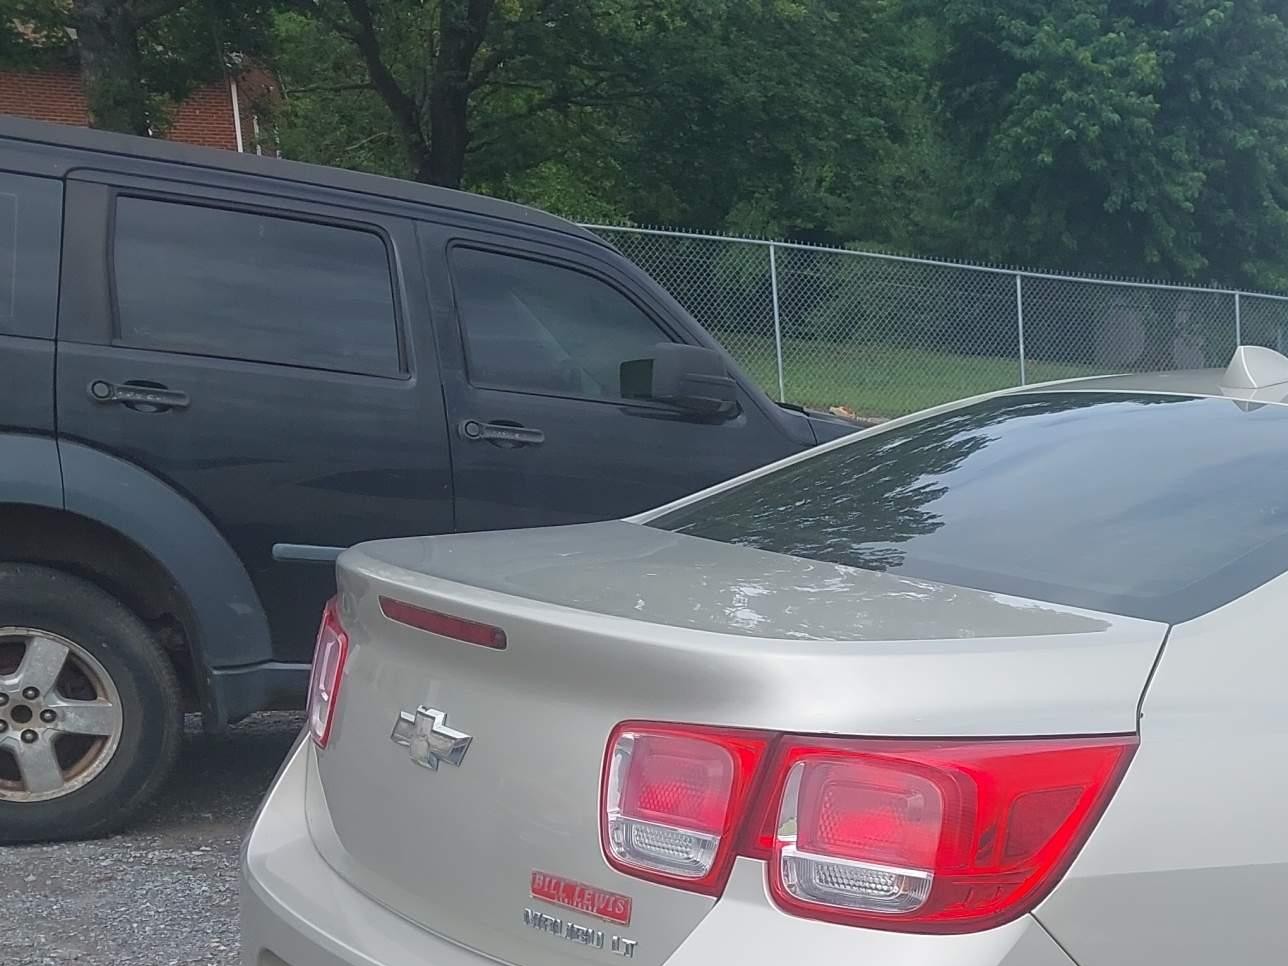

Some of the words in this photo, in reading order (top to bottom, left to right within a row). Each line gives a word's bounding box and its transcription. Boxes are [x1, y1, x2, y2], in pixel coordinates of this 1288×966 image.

[533, 873, 567, 897] BILL
[574, 884, 625, 914] LEWIS
[523, 907, 605, 950] MALIBU
[611, 934, 639, 959] LT
